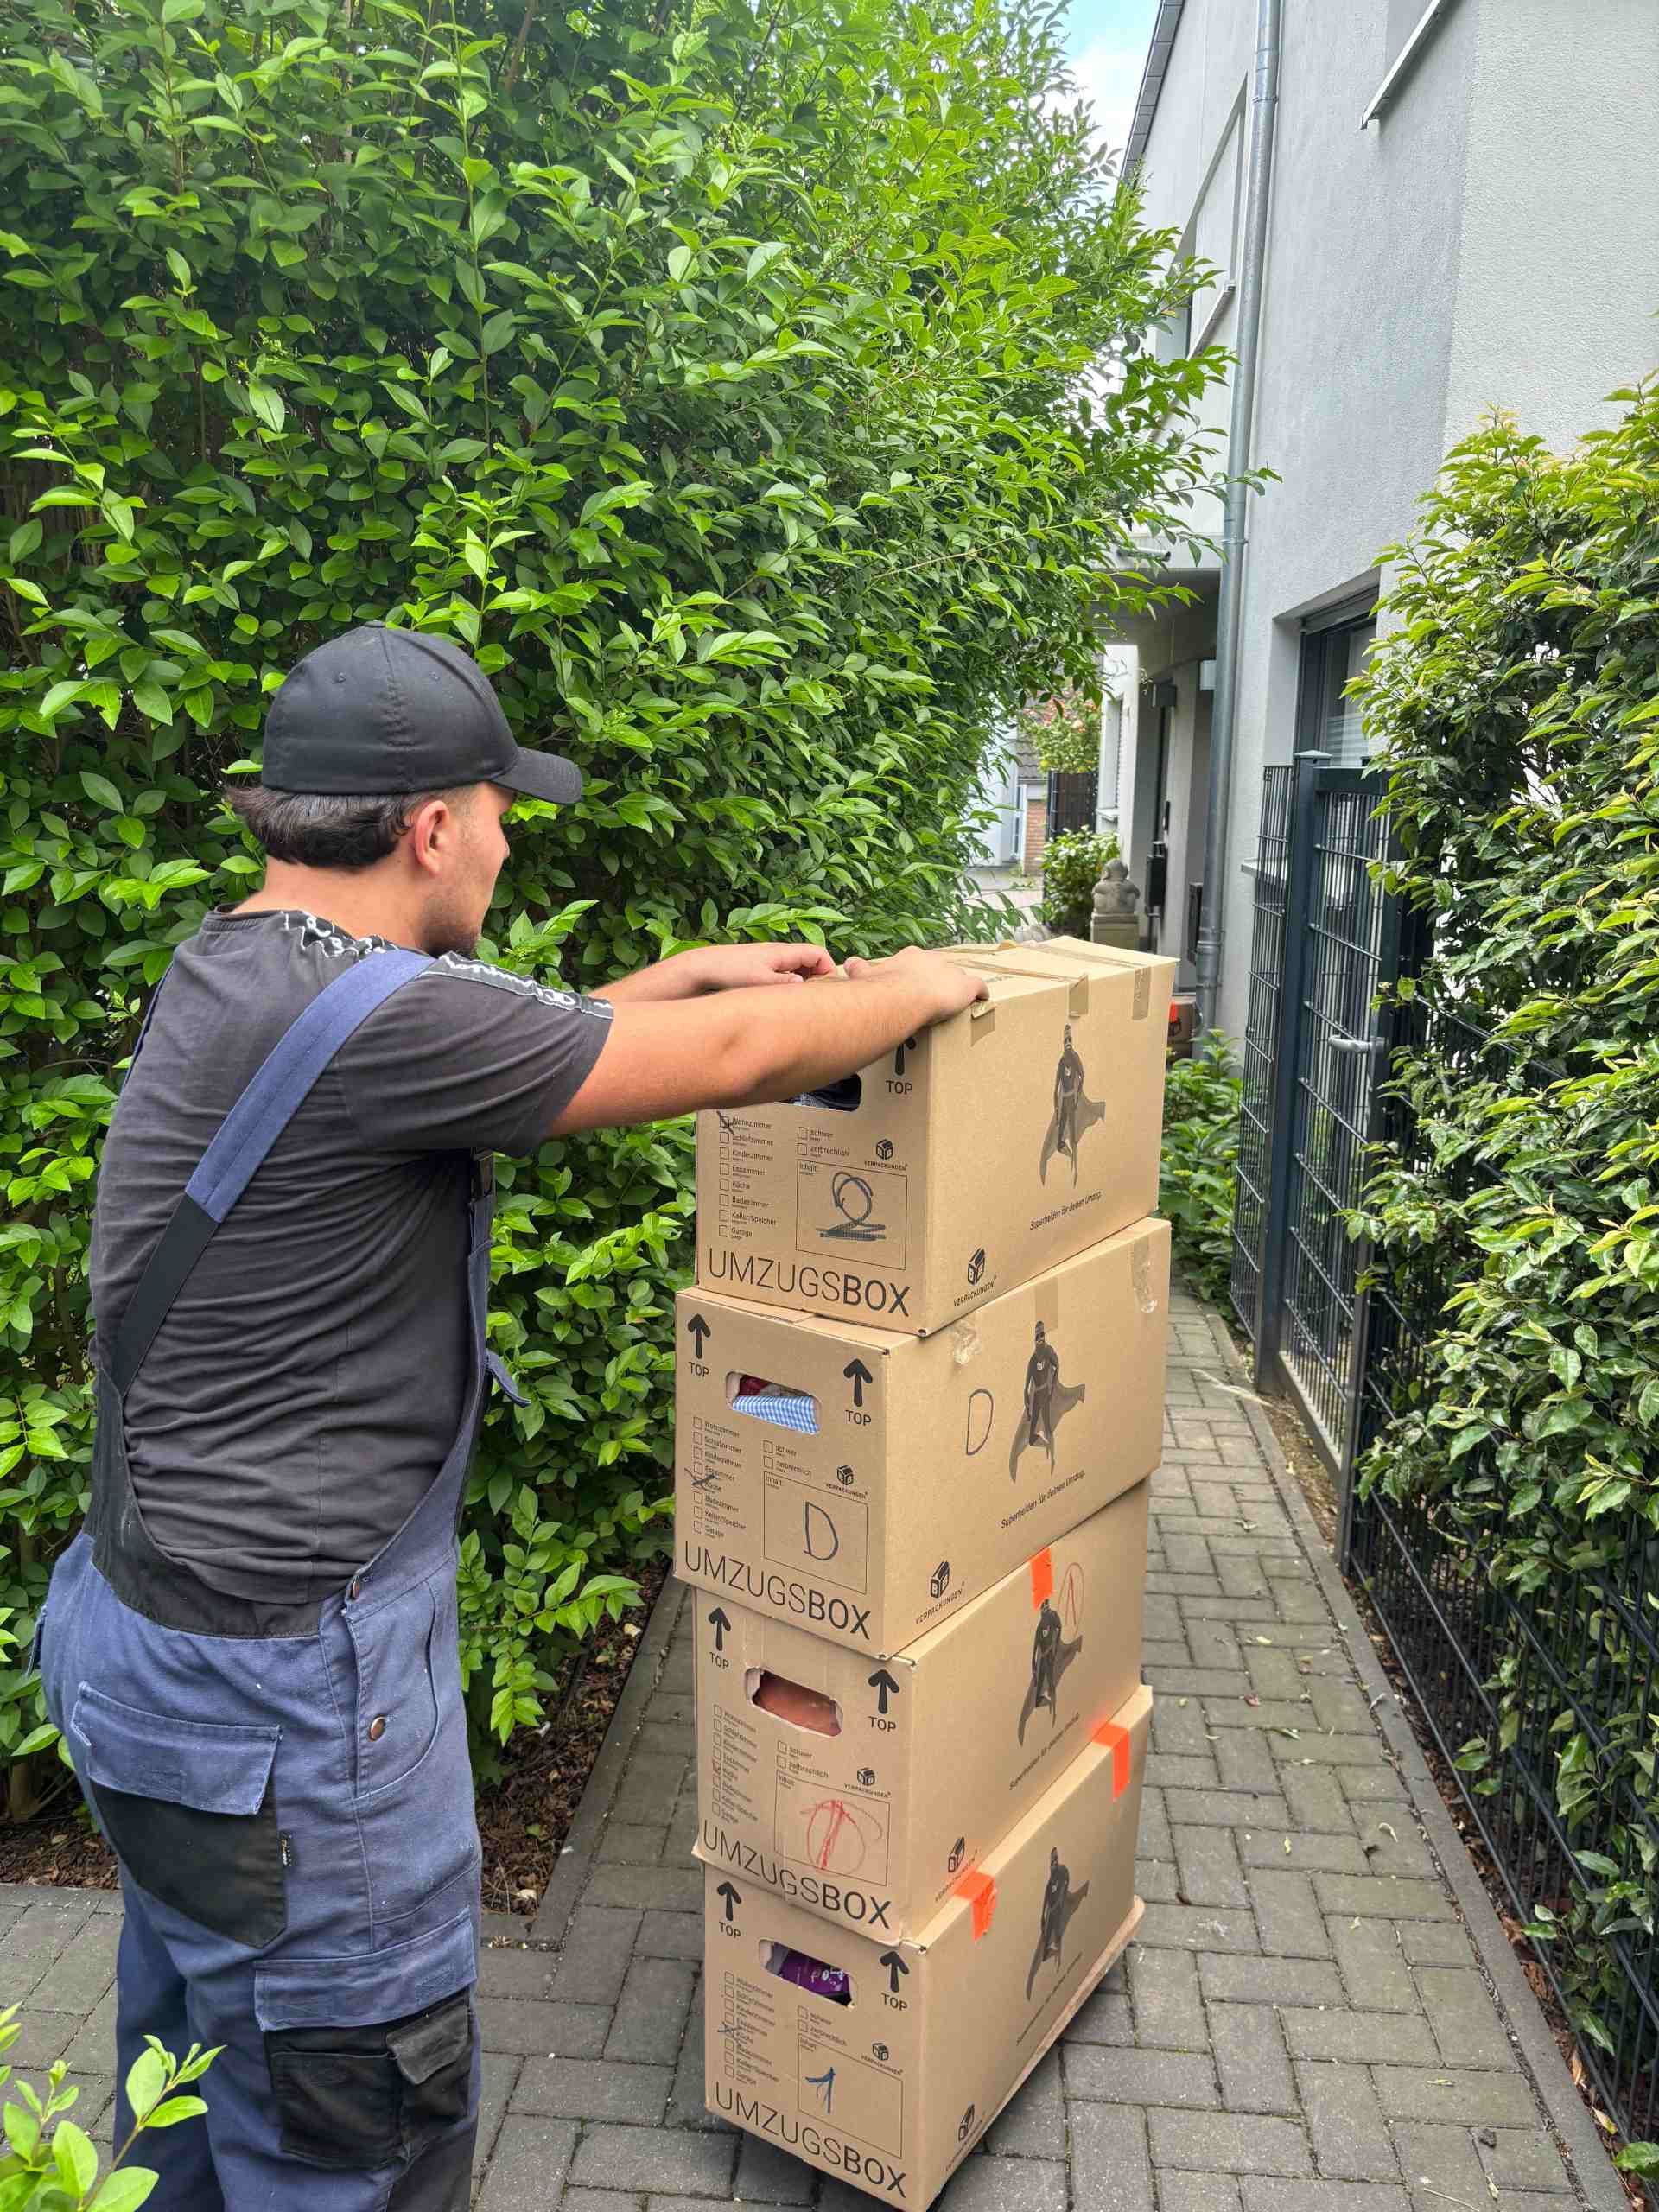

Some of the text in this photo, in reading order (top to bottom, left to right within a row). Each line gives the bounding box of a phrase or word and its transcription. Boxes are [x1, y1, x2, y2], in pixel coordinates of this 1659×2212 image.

[886, 1080, 913, 1095] TOP
[709, 1247, 911, 1318] UMZUGSBOX
[688, 1362, 710, 1377] TOP
[845, 1410, 872, 1426] TOP
[965, 1389, 995, 1456] D
[804, 1502, 839, 1561] D
[685, 1541, 871, 1640] UMZUGSBOX
[709, 1651, 729, 1669] TOP
[868, 1715, 897, 1732] TOP
[702, 1819, 892, 1929] UMZUGSBOX
[718, 1921, 741, 1939] TOP
[880, 1992, 908, 2012] TOP
[715, 2081, 906, 2199] UMZUGSBOX
